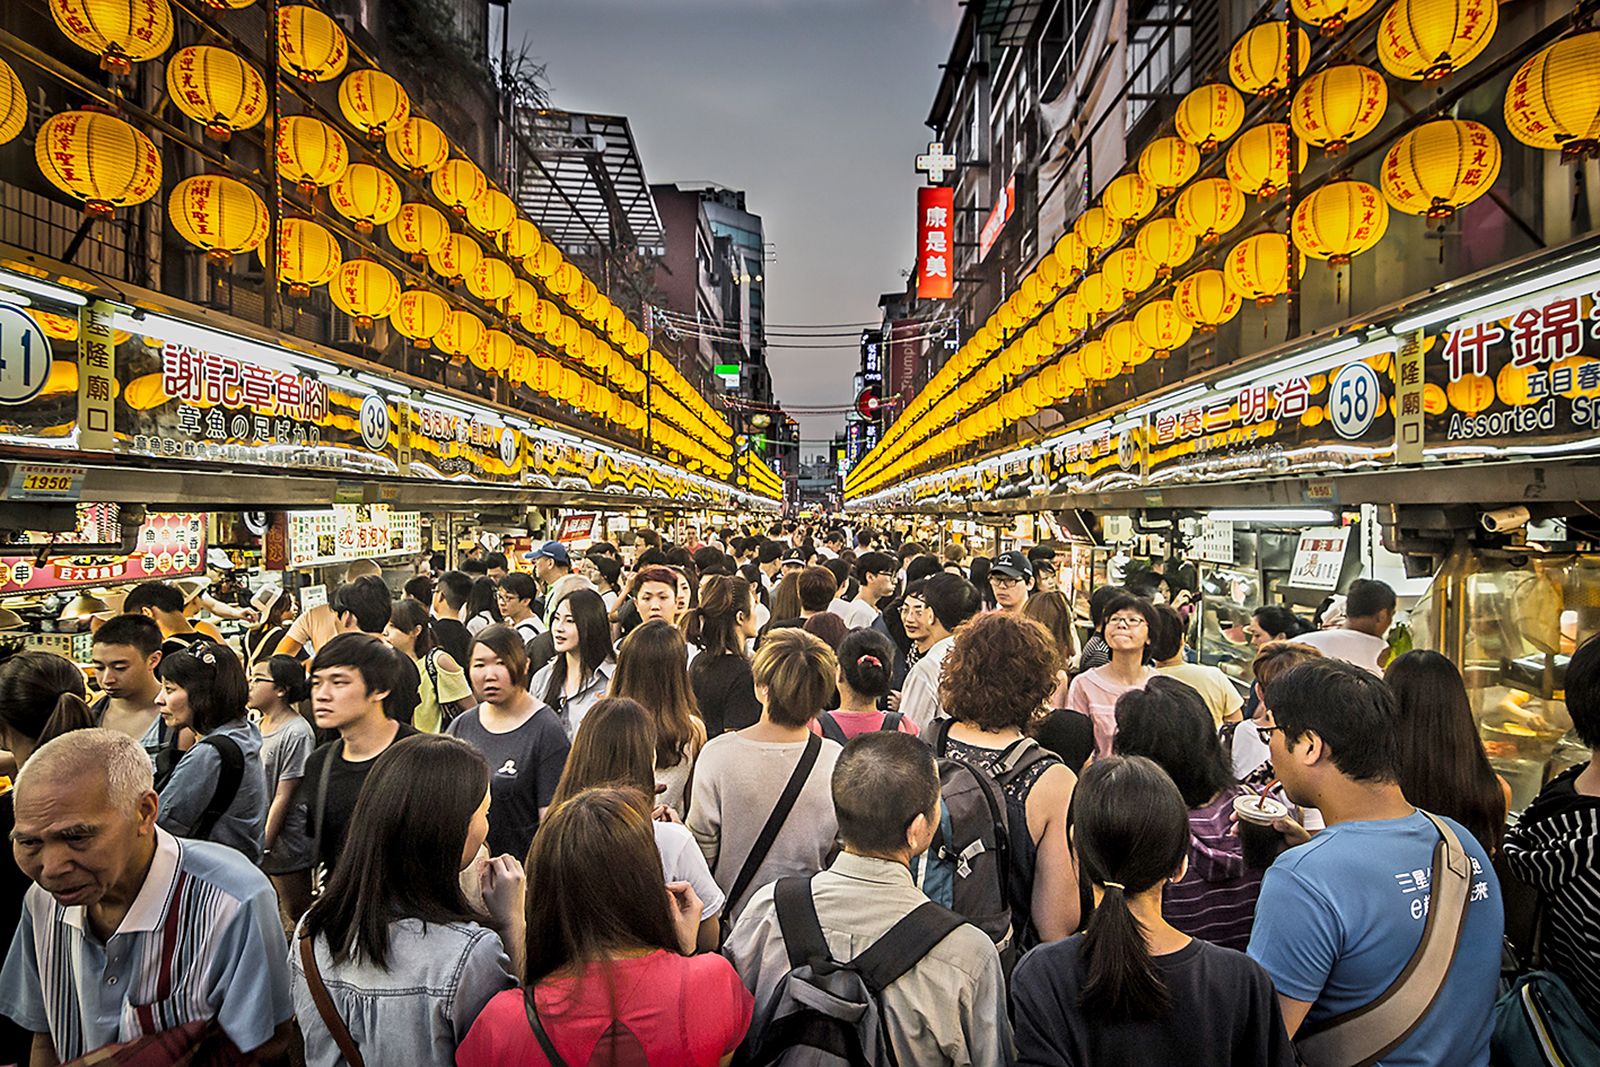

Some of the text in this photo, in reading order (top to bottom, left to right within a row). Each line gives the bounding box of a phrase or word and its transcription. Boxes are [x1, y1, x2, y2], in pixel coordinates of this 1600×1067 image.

[926, 206, 947, 278] 康是美
[1445, 290, 1600, 378] 什錦
[86, 308, 112, 433] 基隆廟口
[163, 342, 329, 424] 謝記章魚腳
[1401, 331, 1420, 445] 基隆廟口
[366, 404, 384, 437] 39
[1339, 375, 1368, 424] 58
[1449, 400, 1554, 438] Assorted
[176, 404, 322, 448] 章魚の足ばかり
[29, 475, 69, 490] 1950
[356, 525, 390, 549] 泡泡冰
[15, 565, 29, 584] 串
